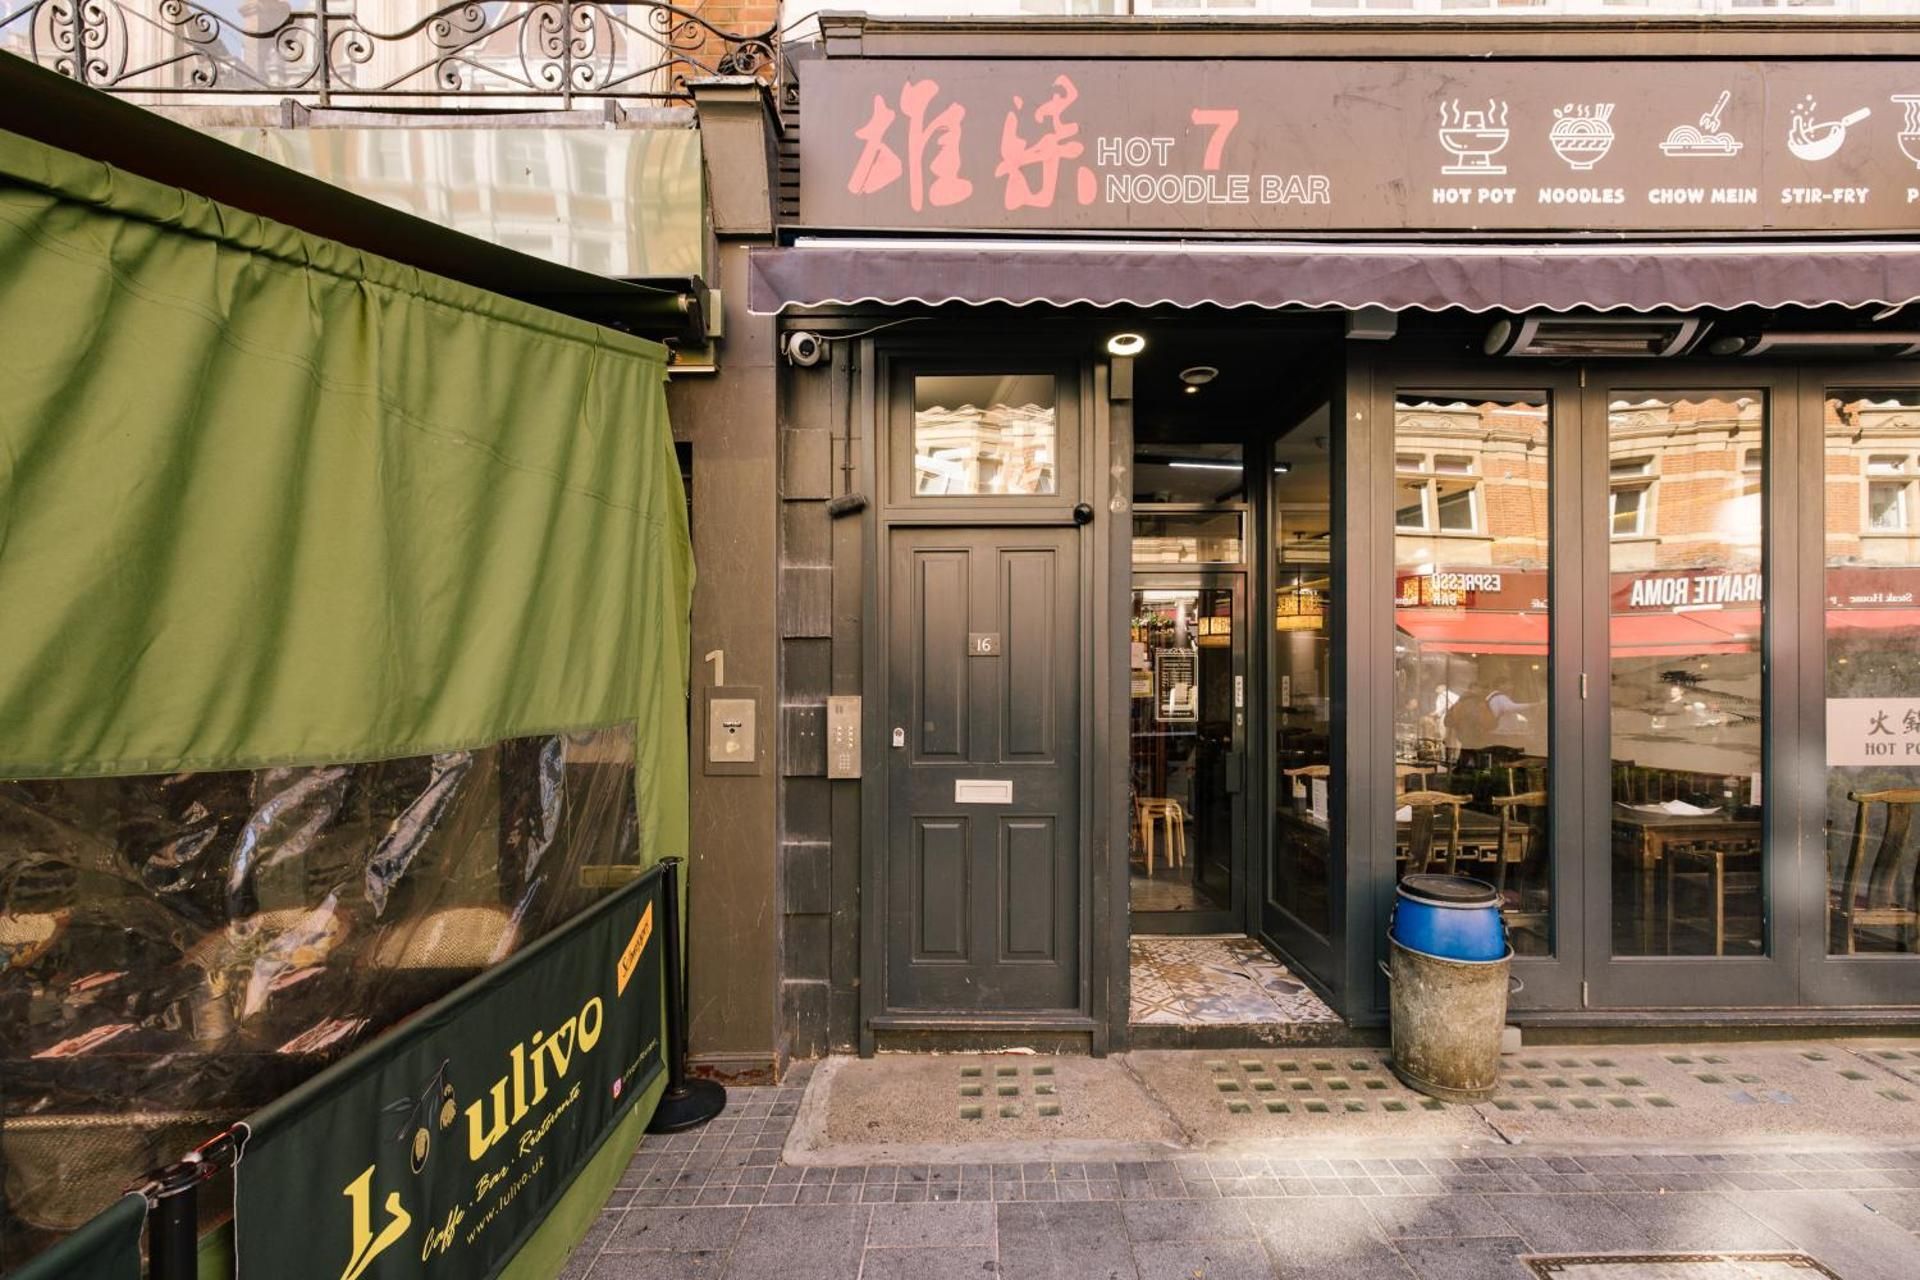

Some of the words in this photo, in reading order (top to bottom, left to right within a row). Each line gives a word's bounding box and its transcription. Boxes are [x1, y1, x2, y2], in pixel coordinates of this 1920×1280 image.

[1097, 136, 1175, 166] HOT
[1191, 108, 1239, 170] 7
[1106, 174, 1250, 204] NOODLE
[1260, 175, 1330, 204] BAR
[1432, 188, 1472, 204] HOT
[1478, 188, 1516, 204] POT
[1538, 188, 1625, 204] NOODLES
[1648, 188, 1704, 204] CHOW
[1711, 188, 1758, 204] MEIN
[1781, 188, 1869, 204] STIR-FRY
[977, 638, 992, 652] 16
[705, 649, 724, 687] 1
[1865, 743, 1897, 755] HOT
[476, 1173, 509, 1202] Bar
[519, 1081, 581, 1158] Ristorante
[466, 1155, 545, 1244] www.lulivo.uk
